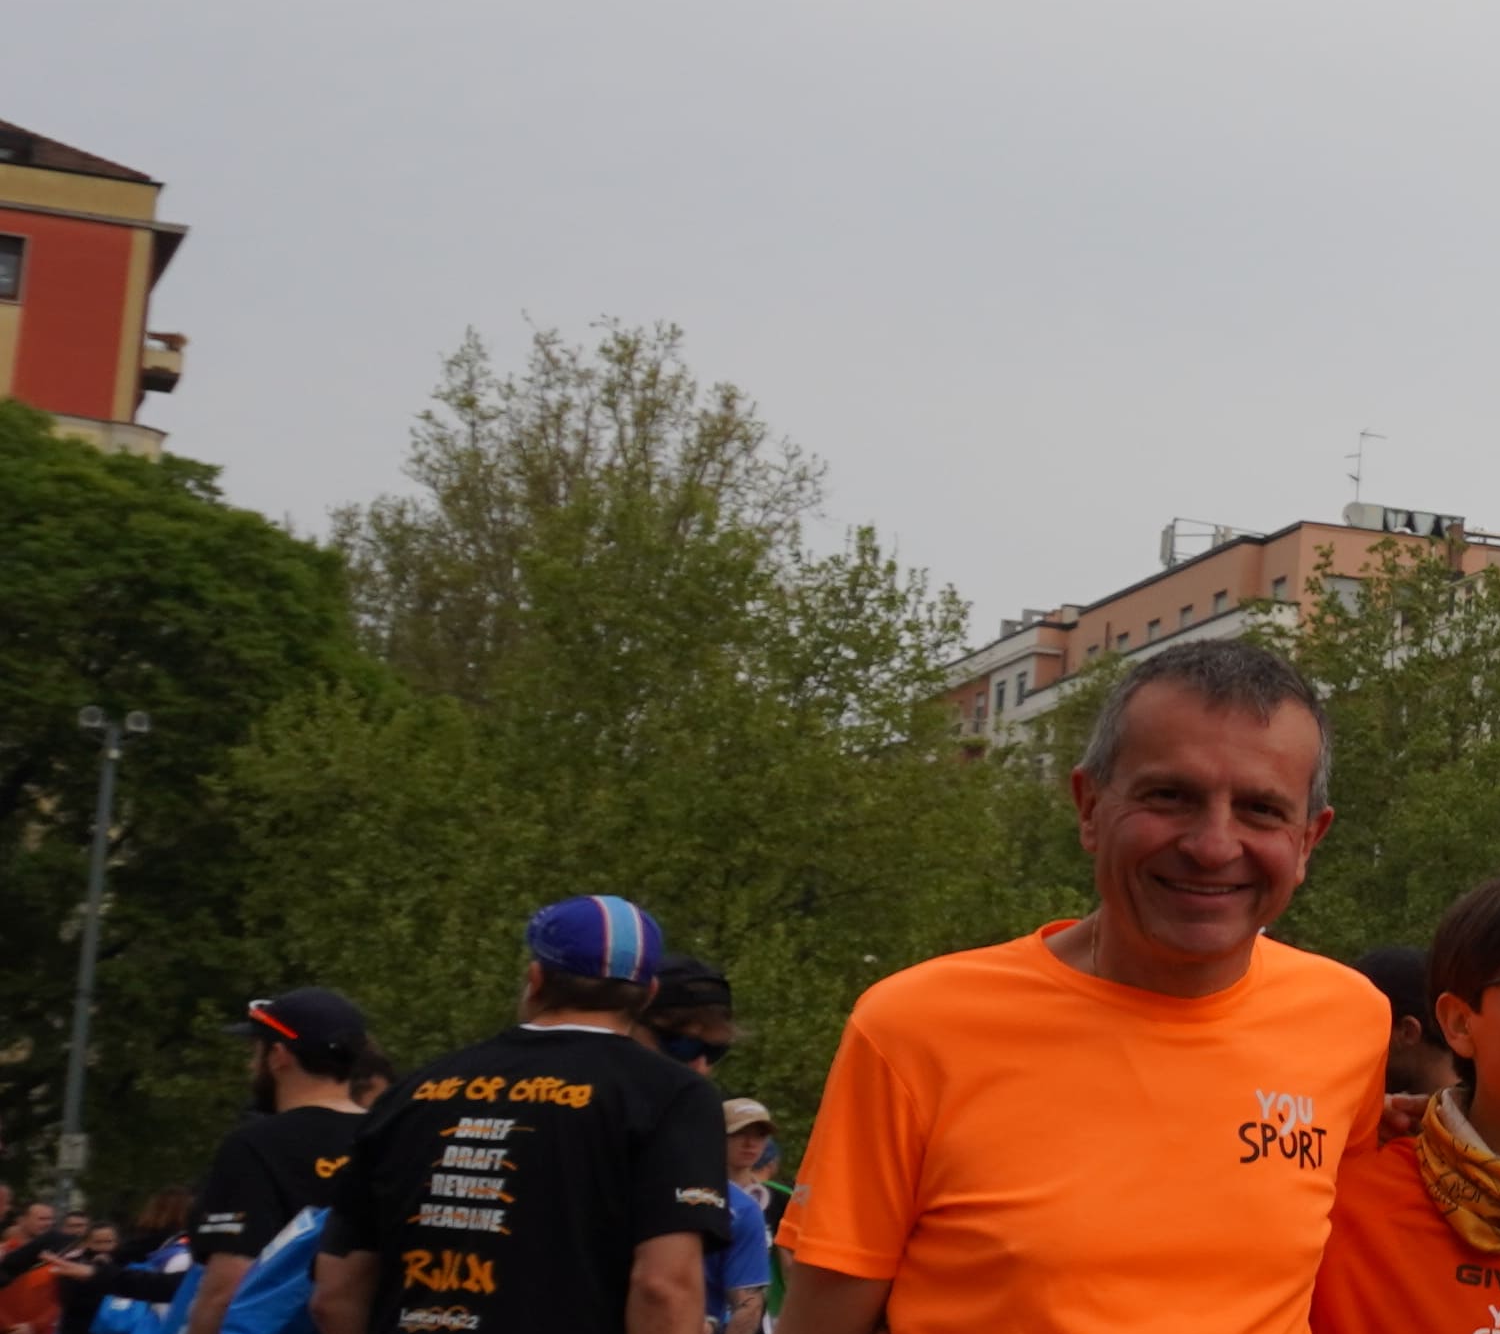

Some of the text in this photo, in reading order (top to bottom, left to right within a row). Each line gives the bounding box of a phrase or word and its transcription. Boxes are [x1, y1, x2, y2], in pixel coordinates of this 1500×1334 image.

[1256, 1089, 1314, 1135] YOU
[442, 1145, 507, 1170] DRAFT
[1239, 1122, 1327, 1170] SPORT
[419, 1204, 504, 1232] DEADLINE
[402, 1249, 495, 1294] RUN
